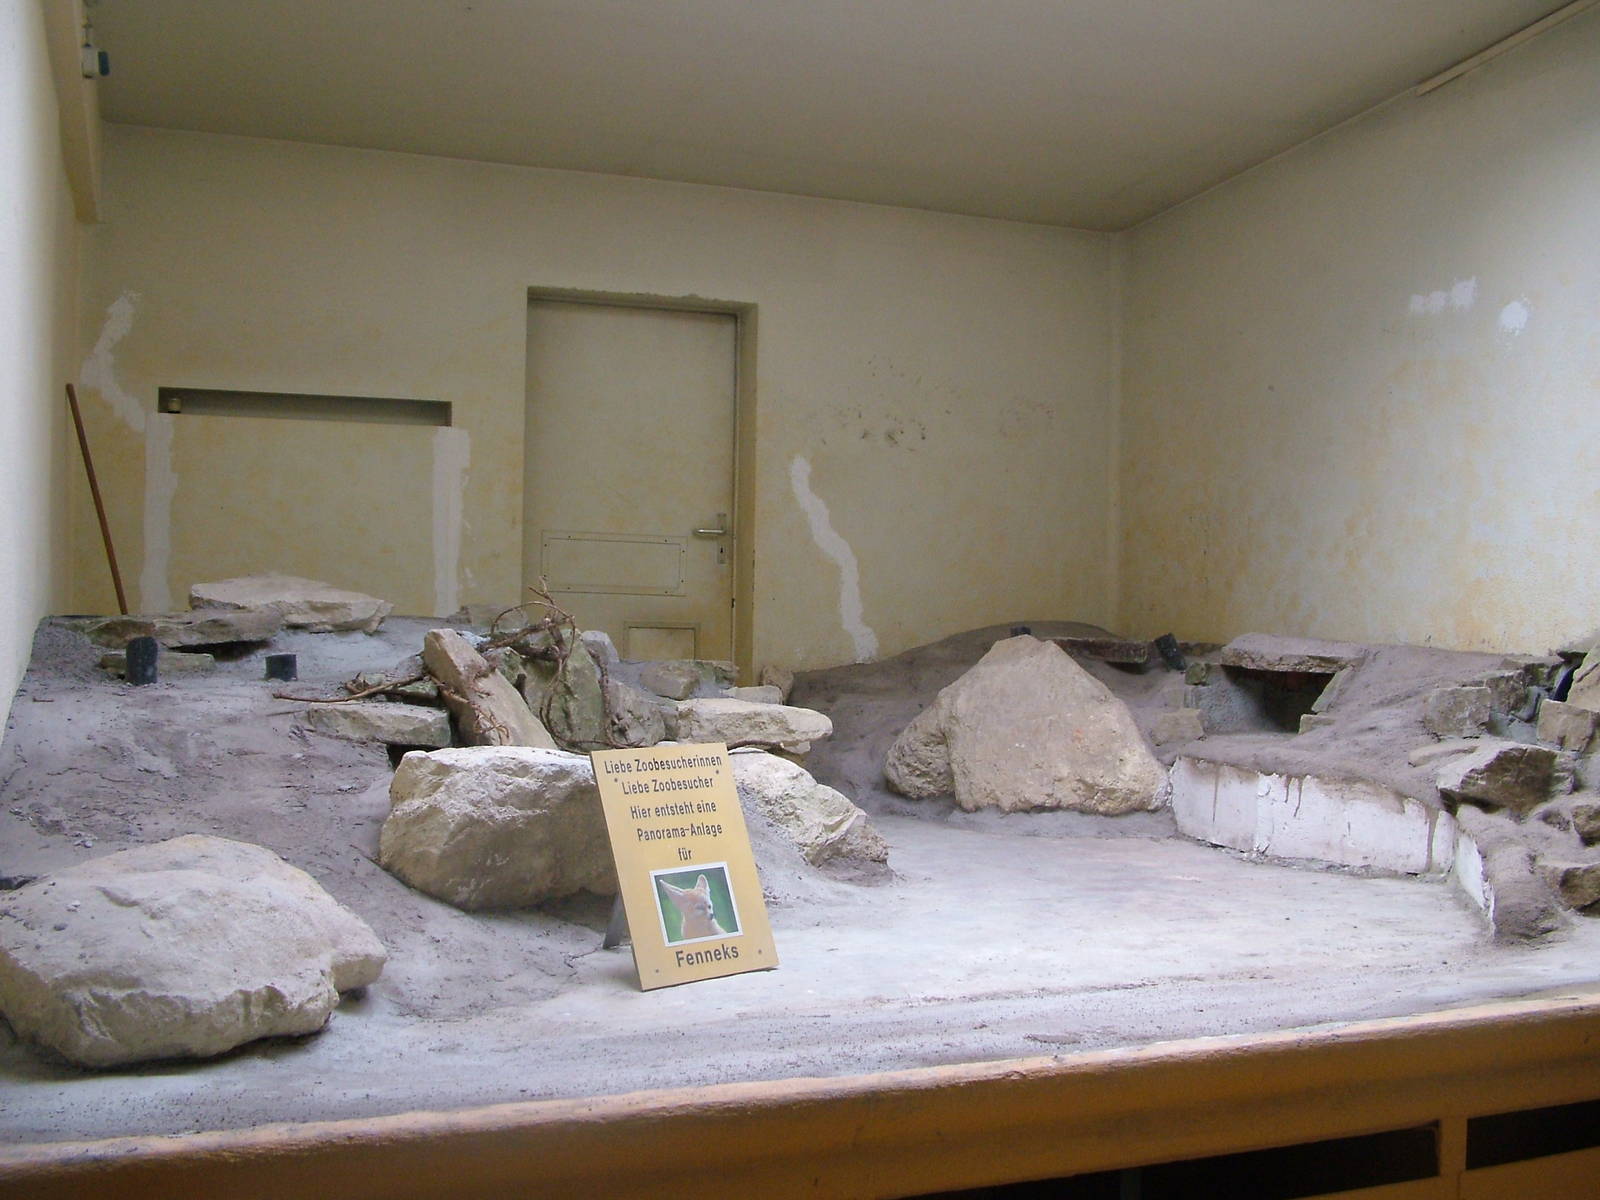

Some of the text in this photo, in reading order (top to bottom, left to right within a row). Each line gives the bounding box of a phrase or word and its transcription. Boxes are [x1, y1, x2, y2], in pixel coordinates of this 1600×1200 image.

[604, 755, 722, 774] Liebe Zoobesucherinnen
[622, 776, 714, 795] Liebe Zoobesucher
[630, 800, 717, 819] Hier entsteht eine
[637, 823, 723, 841] Panorama-Anlage
[678, 847, 692, 861] für
[676, 944, 739, 968] Fenneks
